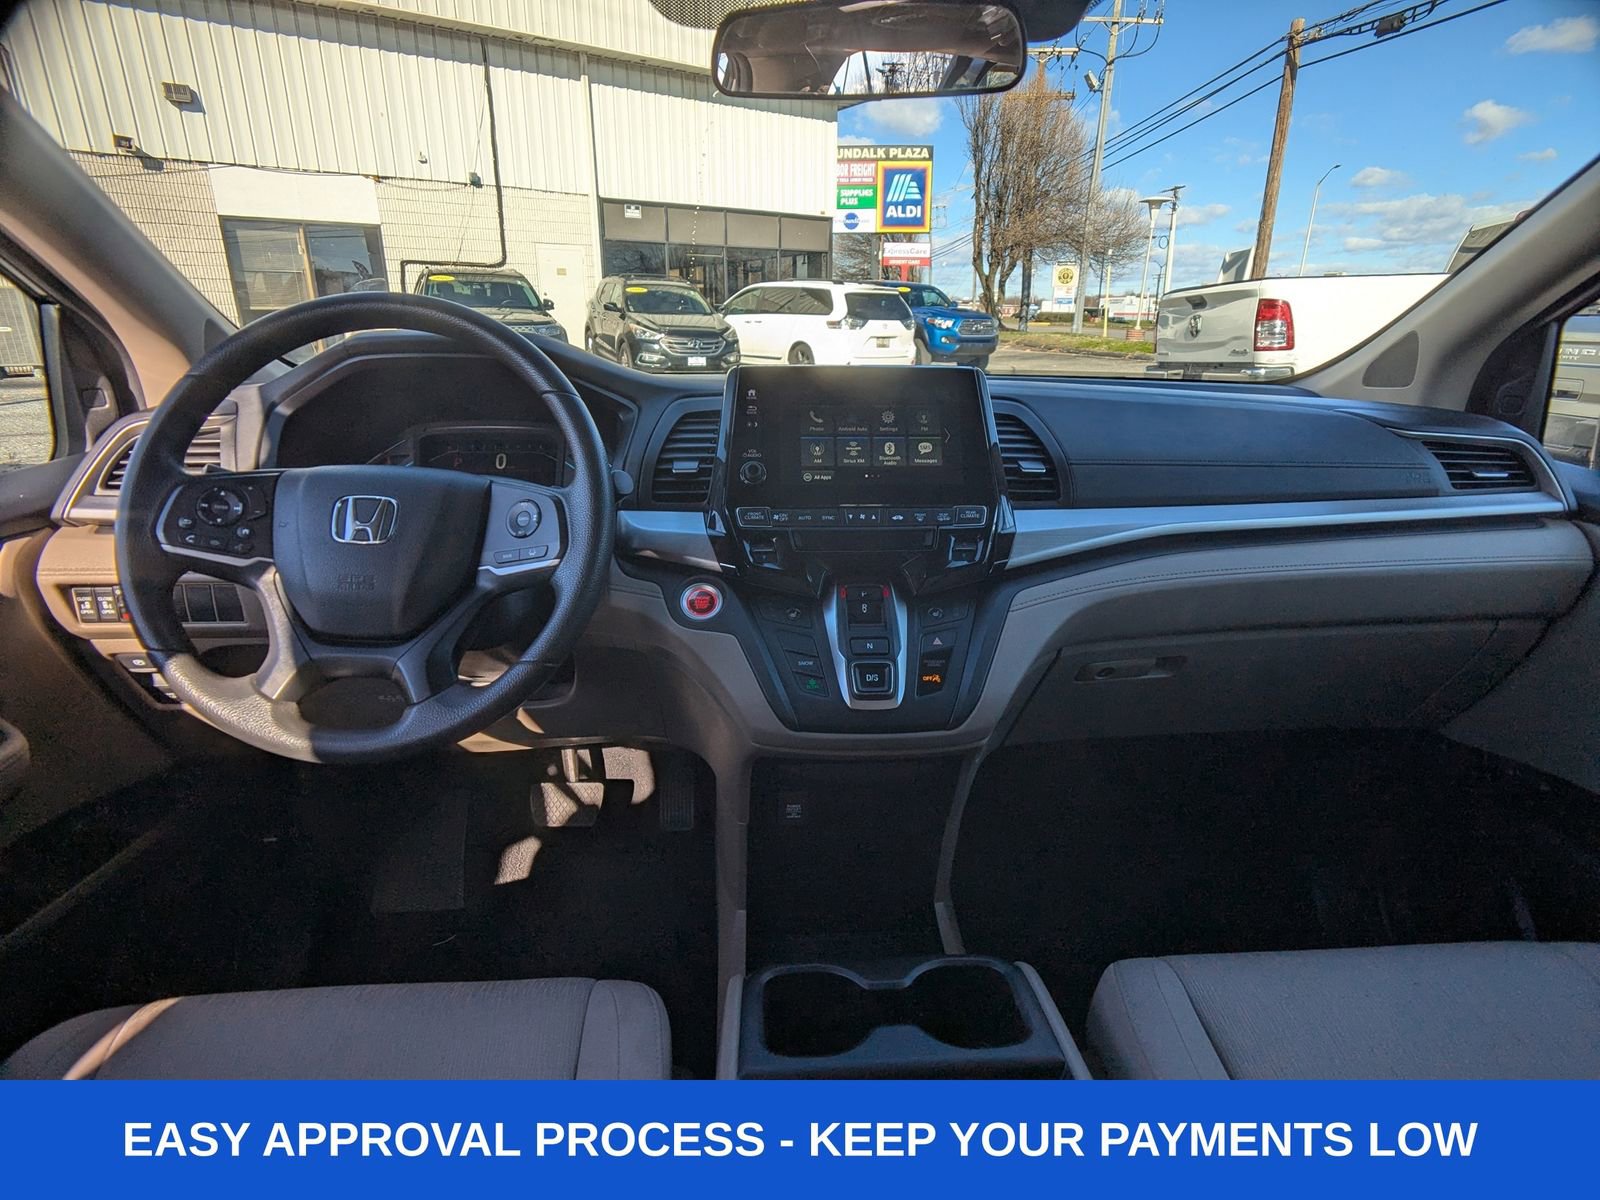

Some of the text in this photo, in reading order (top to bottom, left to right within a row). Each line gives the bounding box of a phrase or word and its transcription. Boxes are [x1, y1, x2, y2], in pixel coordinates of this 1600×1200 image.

[889, 147, 930, 159] PLAZA
[840, 188, 874, 196] SUPPLIES
[840, 197, 858, 206] PLUS
[886, 205, 922, 218] ALDI
[495, 453, 507, 470] 0
[866, 673, 878, 682] D/S
